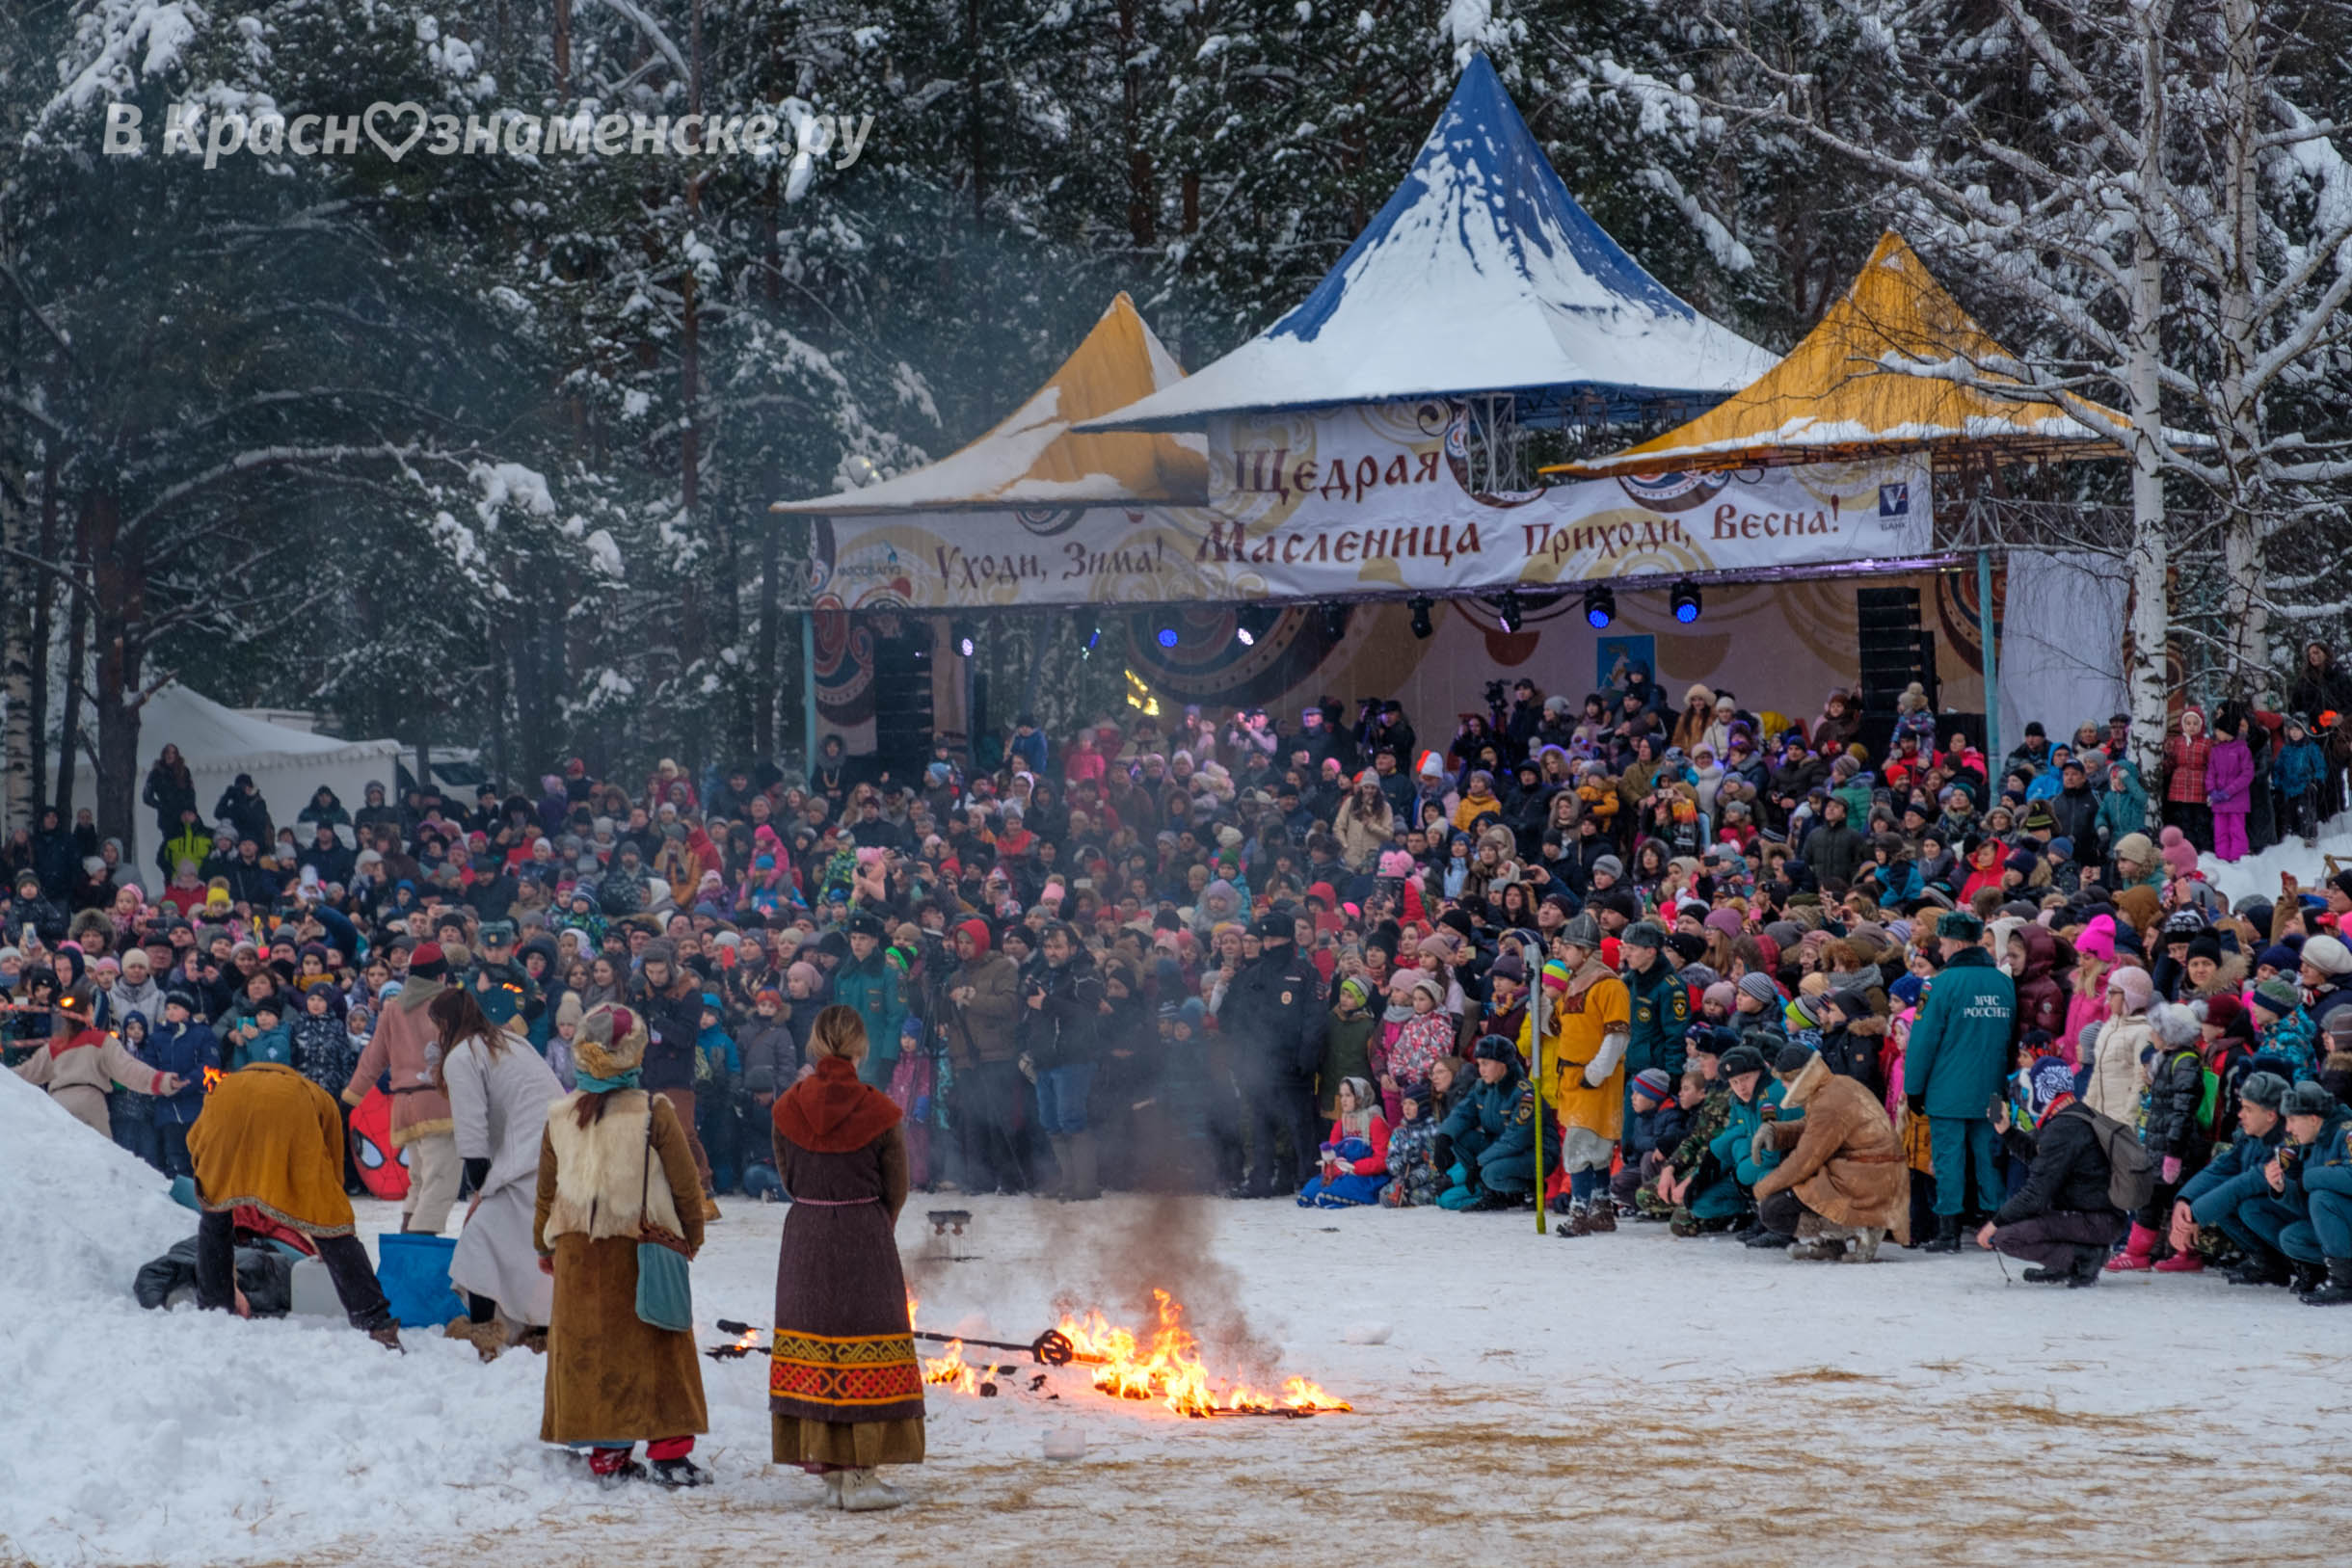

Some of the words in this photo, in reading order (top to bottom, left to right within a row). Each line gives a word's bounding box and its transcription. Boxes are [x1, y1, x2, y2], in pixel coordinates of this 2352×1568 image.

[1235, 448, 1440, 505] Щедрая
[1194, 520, 1481, 566] Масленица
[1522, 518, 1691, 563] Приходи,
[1711, 494, 1839, 540] Весна!
[935, 545, 1047, 590] Уходи,
[1062, 536, 1163, 580] Зима!
[1964, 1007, 2011, 1018] РОССИИ
[1974, 995, 1999, 1006] МЧС
